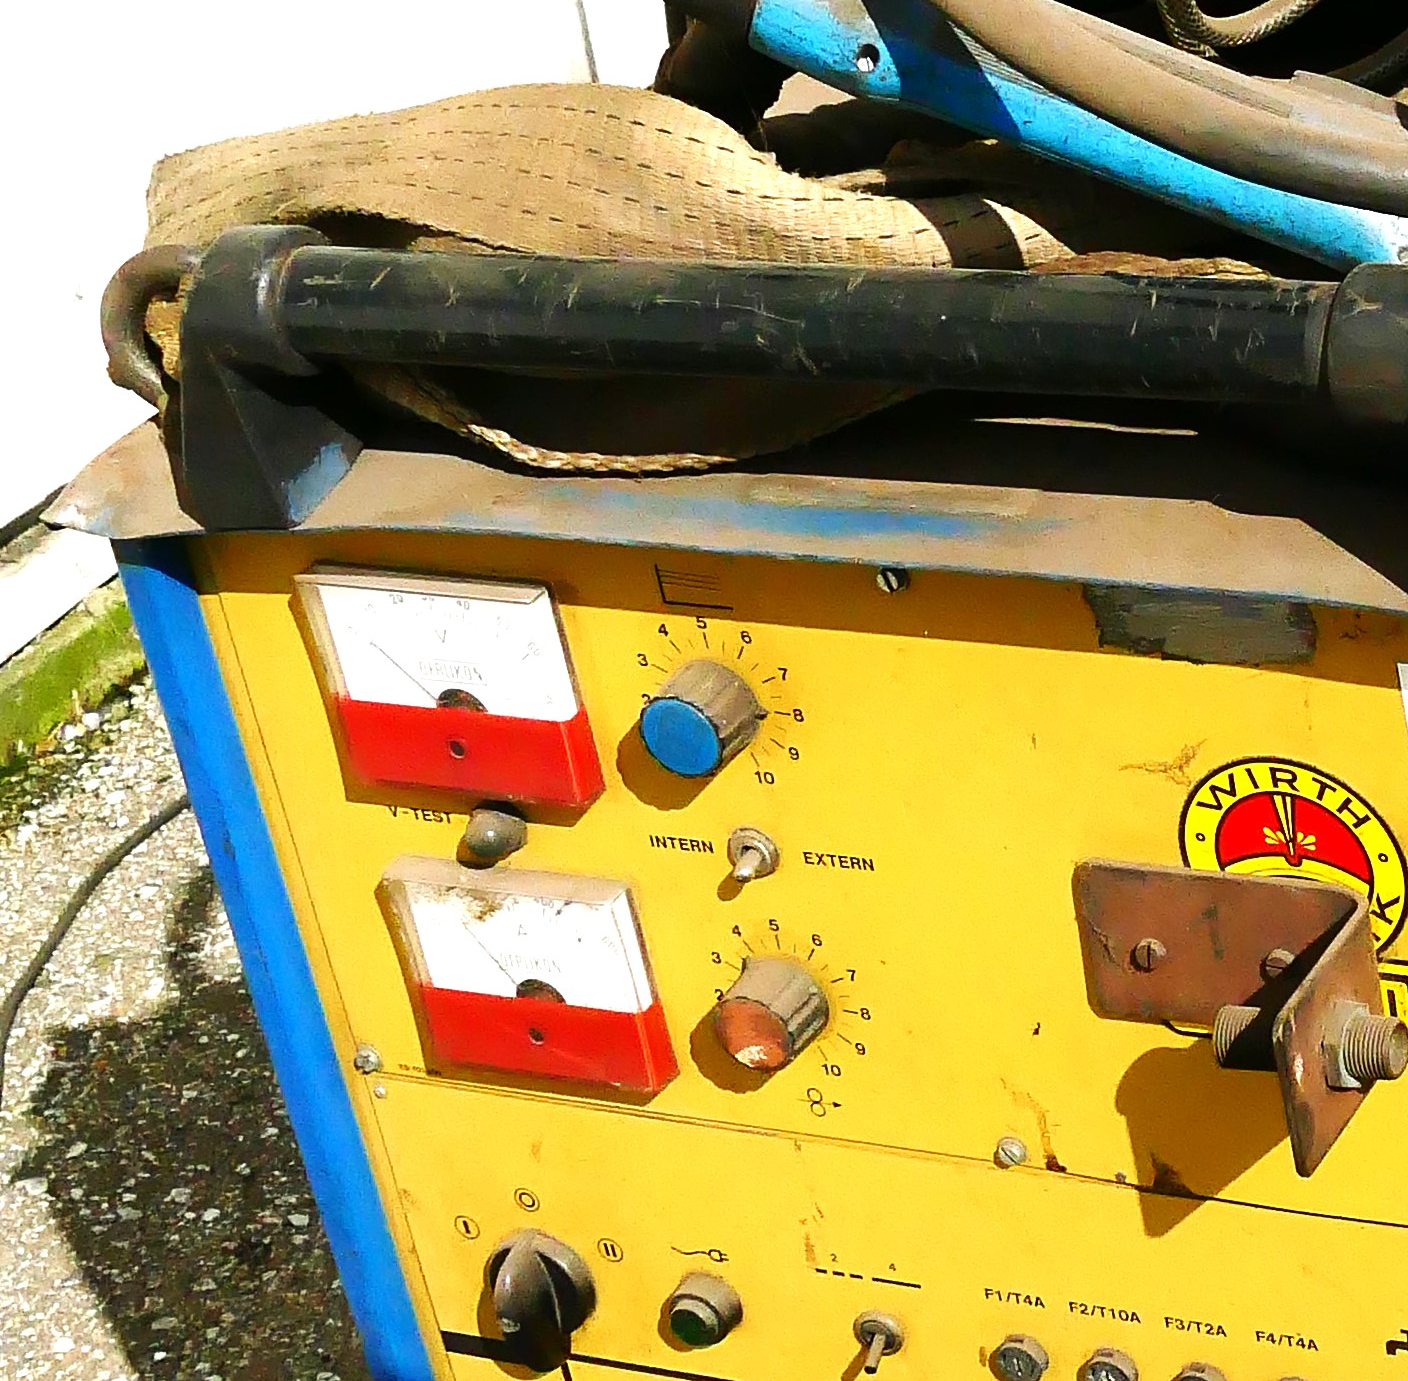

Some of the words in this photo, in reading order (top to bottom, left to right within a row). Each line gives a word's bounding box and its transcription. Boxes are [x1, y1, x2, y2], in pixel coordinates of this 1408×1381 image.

[658, 623, 669, 637] 4
[696, 616, 707, 630] 5
[740, 630, 752, 644] 6
[637, 653, 648, 666] 3
[778, 667, 788, 681] 7
[793, 708, 804, 723] 8
[788, 747, 800, 760] 9
[754, 770, 775, 785] 10
[1195, 766, 1372, 830] WIRTH
[388, 804, 453, 824] V-TEST
[649, 834, 715, 854] INTERN
[803, 851, 875, 872] EXTERN
[731, 925, 742, 937] 4
[768, 919, 780, 932] 5
[811, 934, 823, 947] 6
[711, 952, 722, 964] 3
[846, 969, 856, 981] 7
[860, 1007, 871, 1021] 8
[855, 1042, 866, 1056] 9
[821, 1064, 842, 1077] 10
[984, 1287, 1046, 1309] F1/T4A
[1069, 1301, 1142, 1324] F2/T10A
[1164, 1316, 1228, 1338] F3/T2A
[1255, 1330, 1320, 1352] F4/T4A
